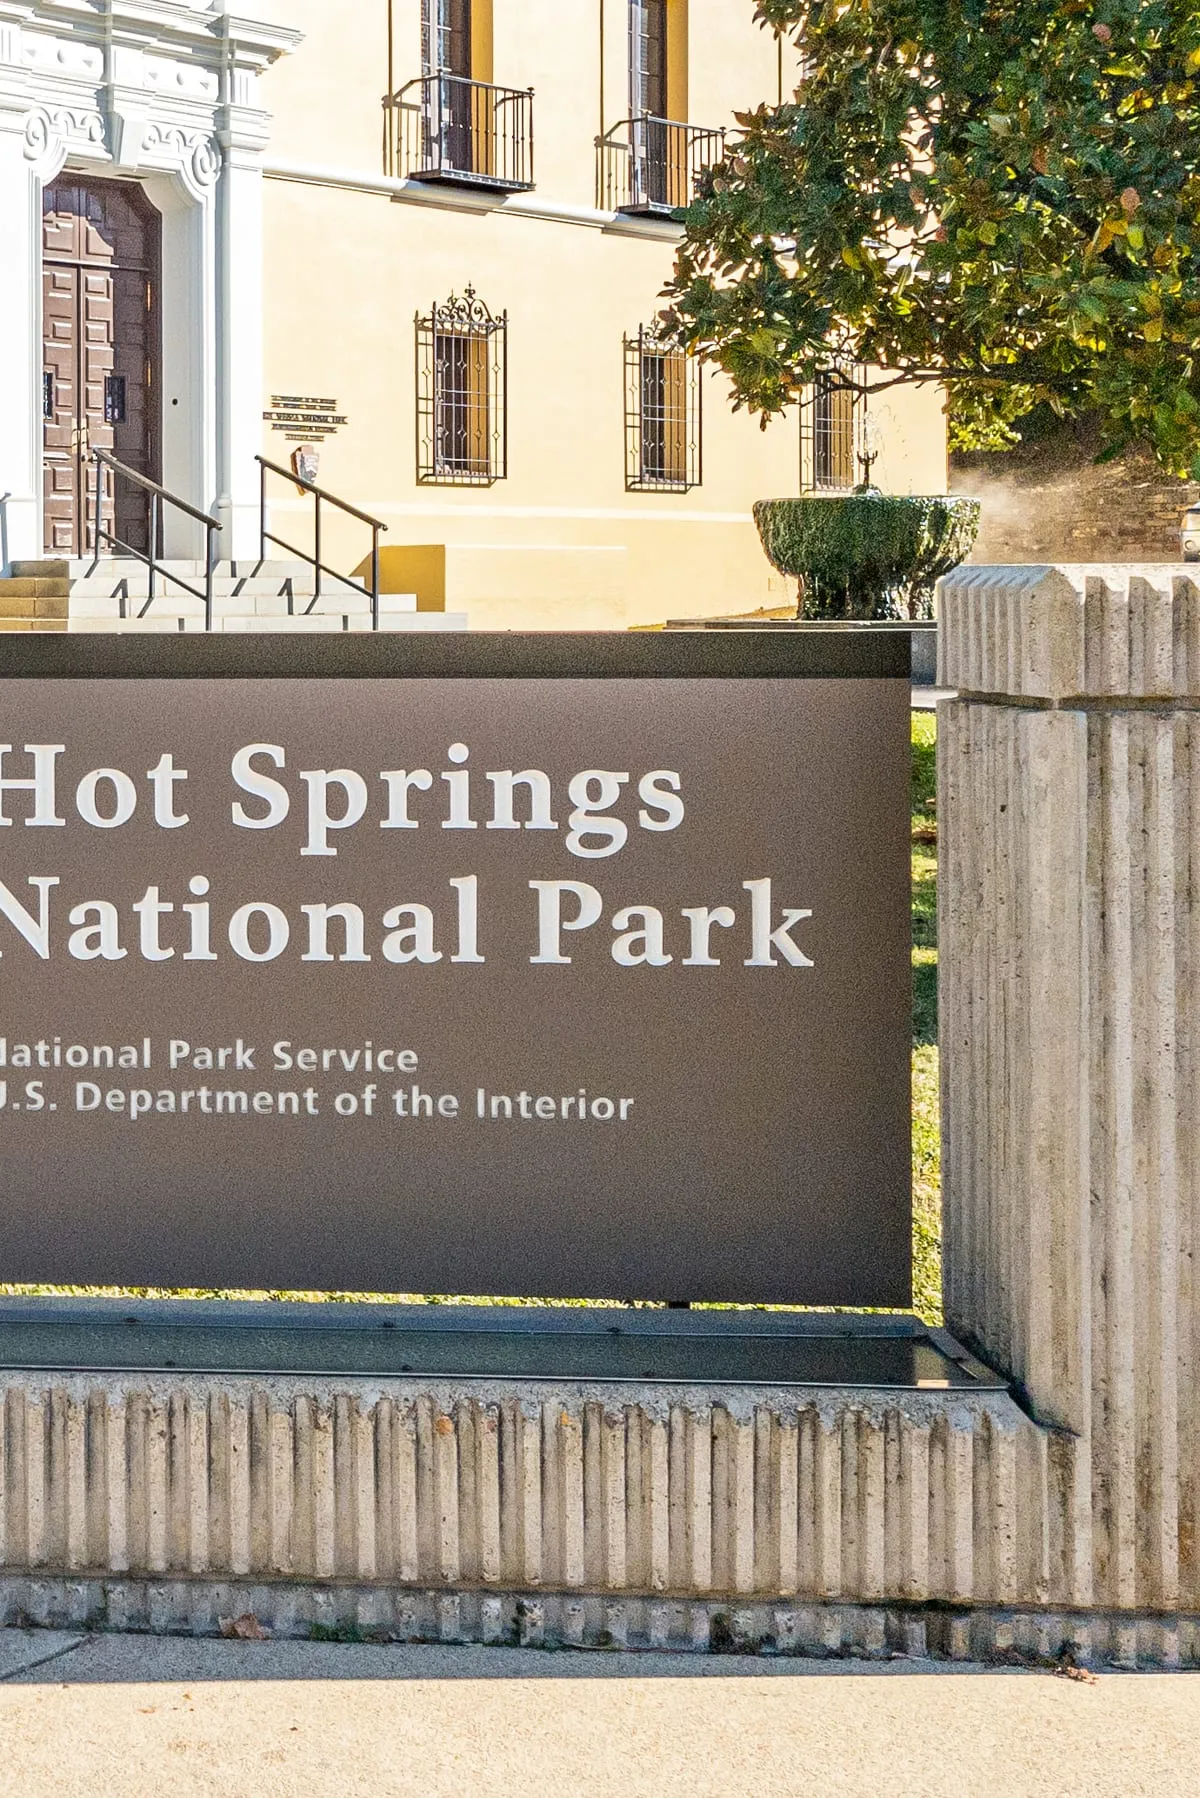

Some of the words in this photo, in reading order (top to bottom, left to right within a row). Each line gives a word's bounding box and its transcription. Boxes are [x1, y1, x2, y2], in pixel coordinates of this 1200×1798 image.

[230, 742, 686, 860] Springs
[527, 876, 815, 968] Park
[169, 1039, 256, 1070] Park
[272, 1041, 419, 1073] Service
[75, 1082, 320, 1121] Department
[333, 1084, 378, 1116] of
[392, 1085, 460, 1117] the
[476, 1088, 635, 1122] Interior
